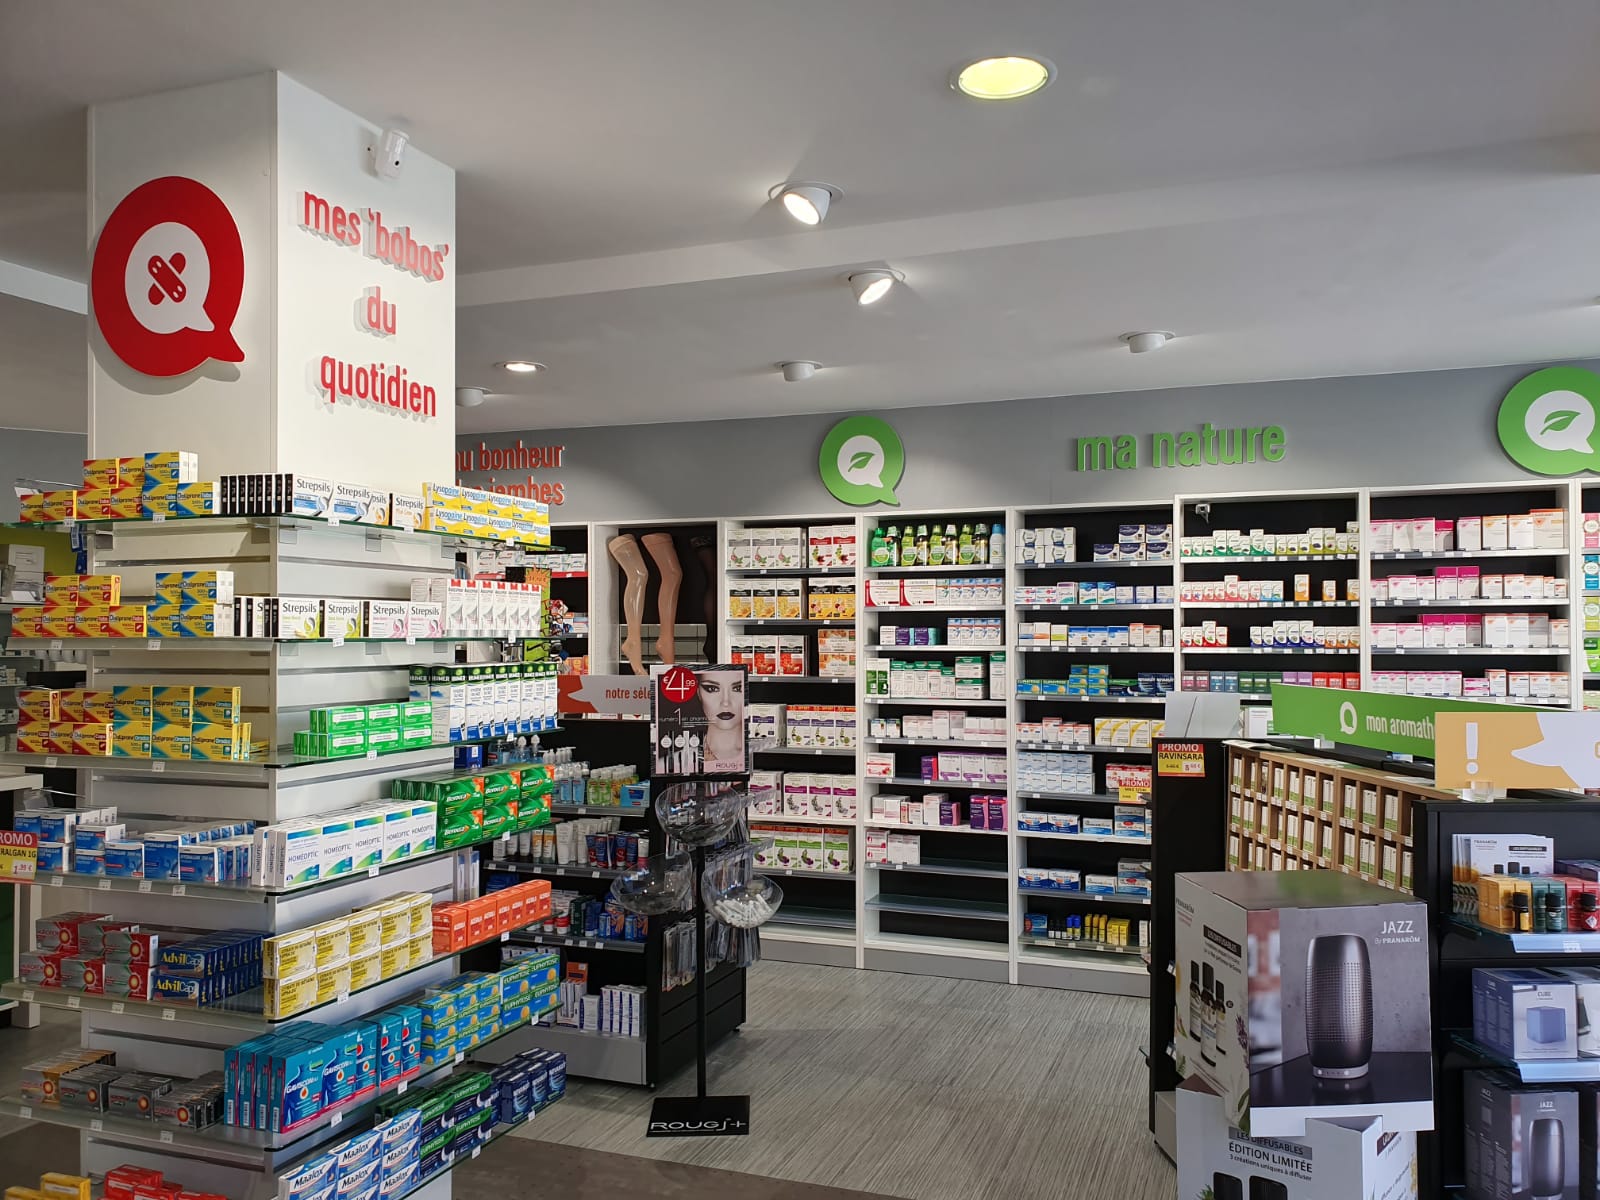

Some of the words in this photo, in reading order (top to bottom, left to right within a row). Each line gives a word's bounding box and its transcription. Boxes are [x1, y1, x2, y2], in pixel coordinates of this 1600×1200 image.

[304, 191, 361, 246] mes
[367, 286, 396, 334] du
[320, 355, 436, 417] quotidien
[479, 440, 565, 472] bonheur
[1076, 434, 1137, 472] ma
[1152, 422, 1287, 468] nature
[297, 478, 331, 493] Strepsils
[337, 485, 370, 500] Strepsils
[396, 497, 424, 510] Strepsils
[282, 602, 317, 613] Strepsils
[328, 603, 358, 615] Strepsils
[373, 604, 405, 616] Strepsils
[411, 606, 439, 617] Strepsils
[605, 688, 630, 699] notre
[1366, 714, 1388, 733] mon
[1390, 714, 1435, 740] aromath
[1159, 752, 1203, 760] RAVINSARA
[1161, 743, 1199, 752] PROMO
[28, 850, 37, 858] 1G
[1381, 920, 1414, 935] JAZZ
[387, 1115, 414, 1138] Maalox
[1236, 1131, 1249, 1140] LES
[342, 1140, 371, 1163] Maalox
[386, 1140, 413, 1163] Maalox
[1229, 1141, 1270, 1162] ÉDITION
[1272, 1153, 1313, 1173] LIMITÉE
[293, 1165, 325, 1190] Maalox
[341, 1164, 371, 1190] Maalox
[384, 1165, 411, 1191] Maalox
[1234, 1155, 1260, 1168] créations
[1260, 1162, 1284, 1174] uniques
[1289, 1169, 1312, 1181] diffuser
